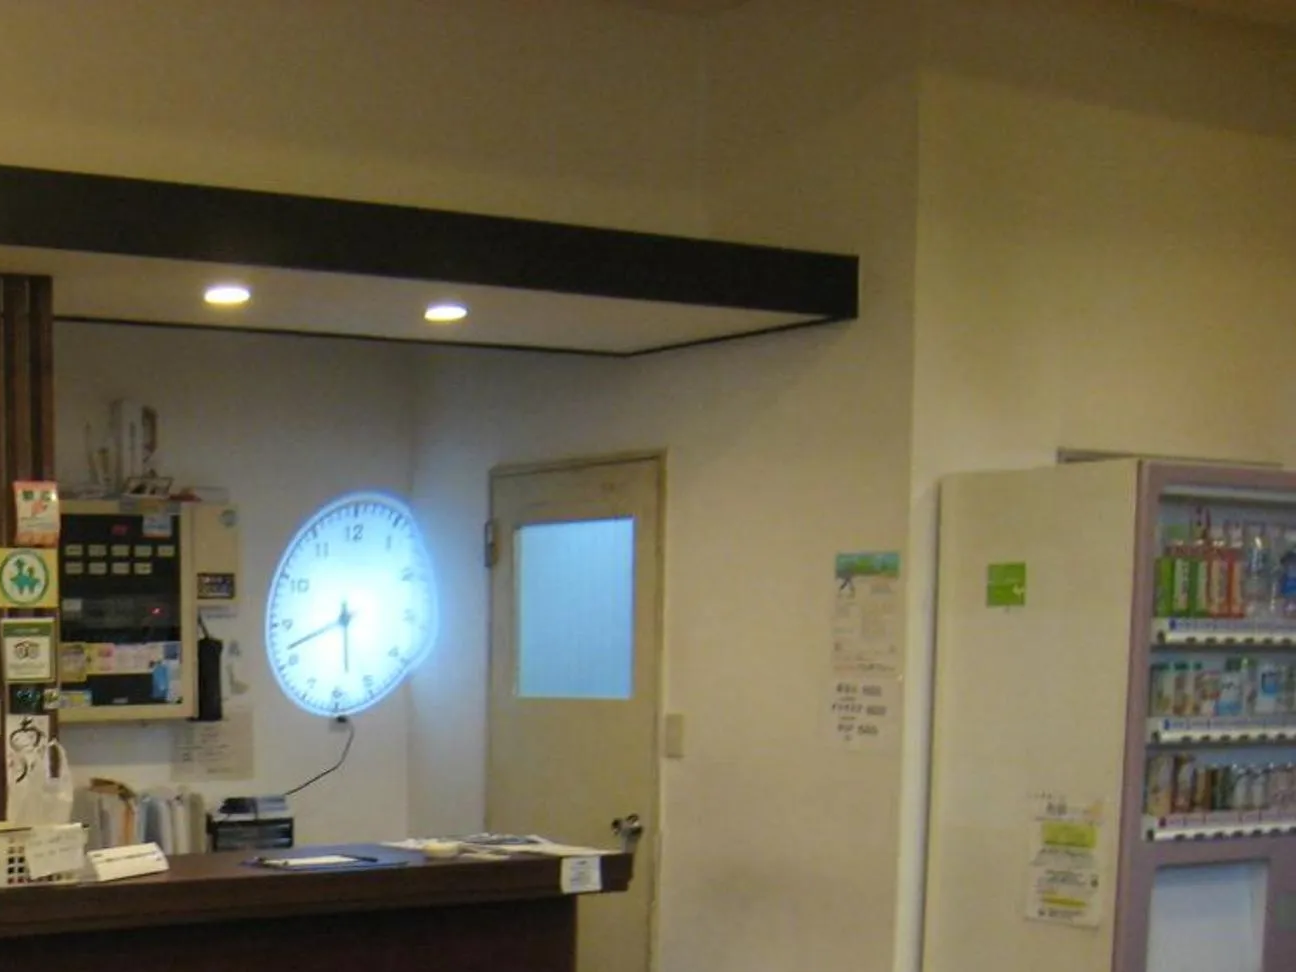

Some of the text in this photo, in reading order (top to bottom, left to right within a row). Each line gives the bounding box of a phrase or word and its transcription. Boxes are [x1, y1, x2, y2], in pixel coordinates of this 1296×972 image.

[344, 524, 364, 542] 12
[315, 543, 329, 558] 11
[290, 578, 310, 593] 10
